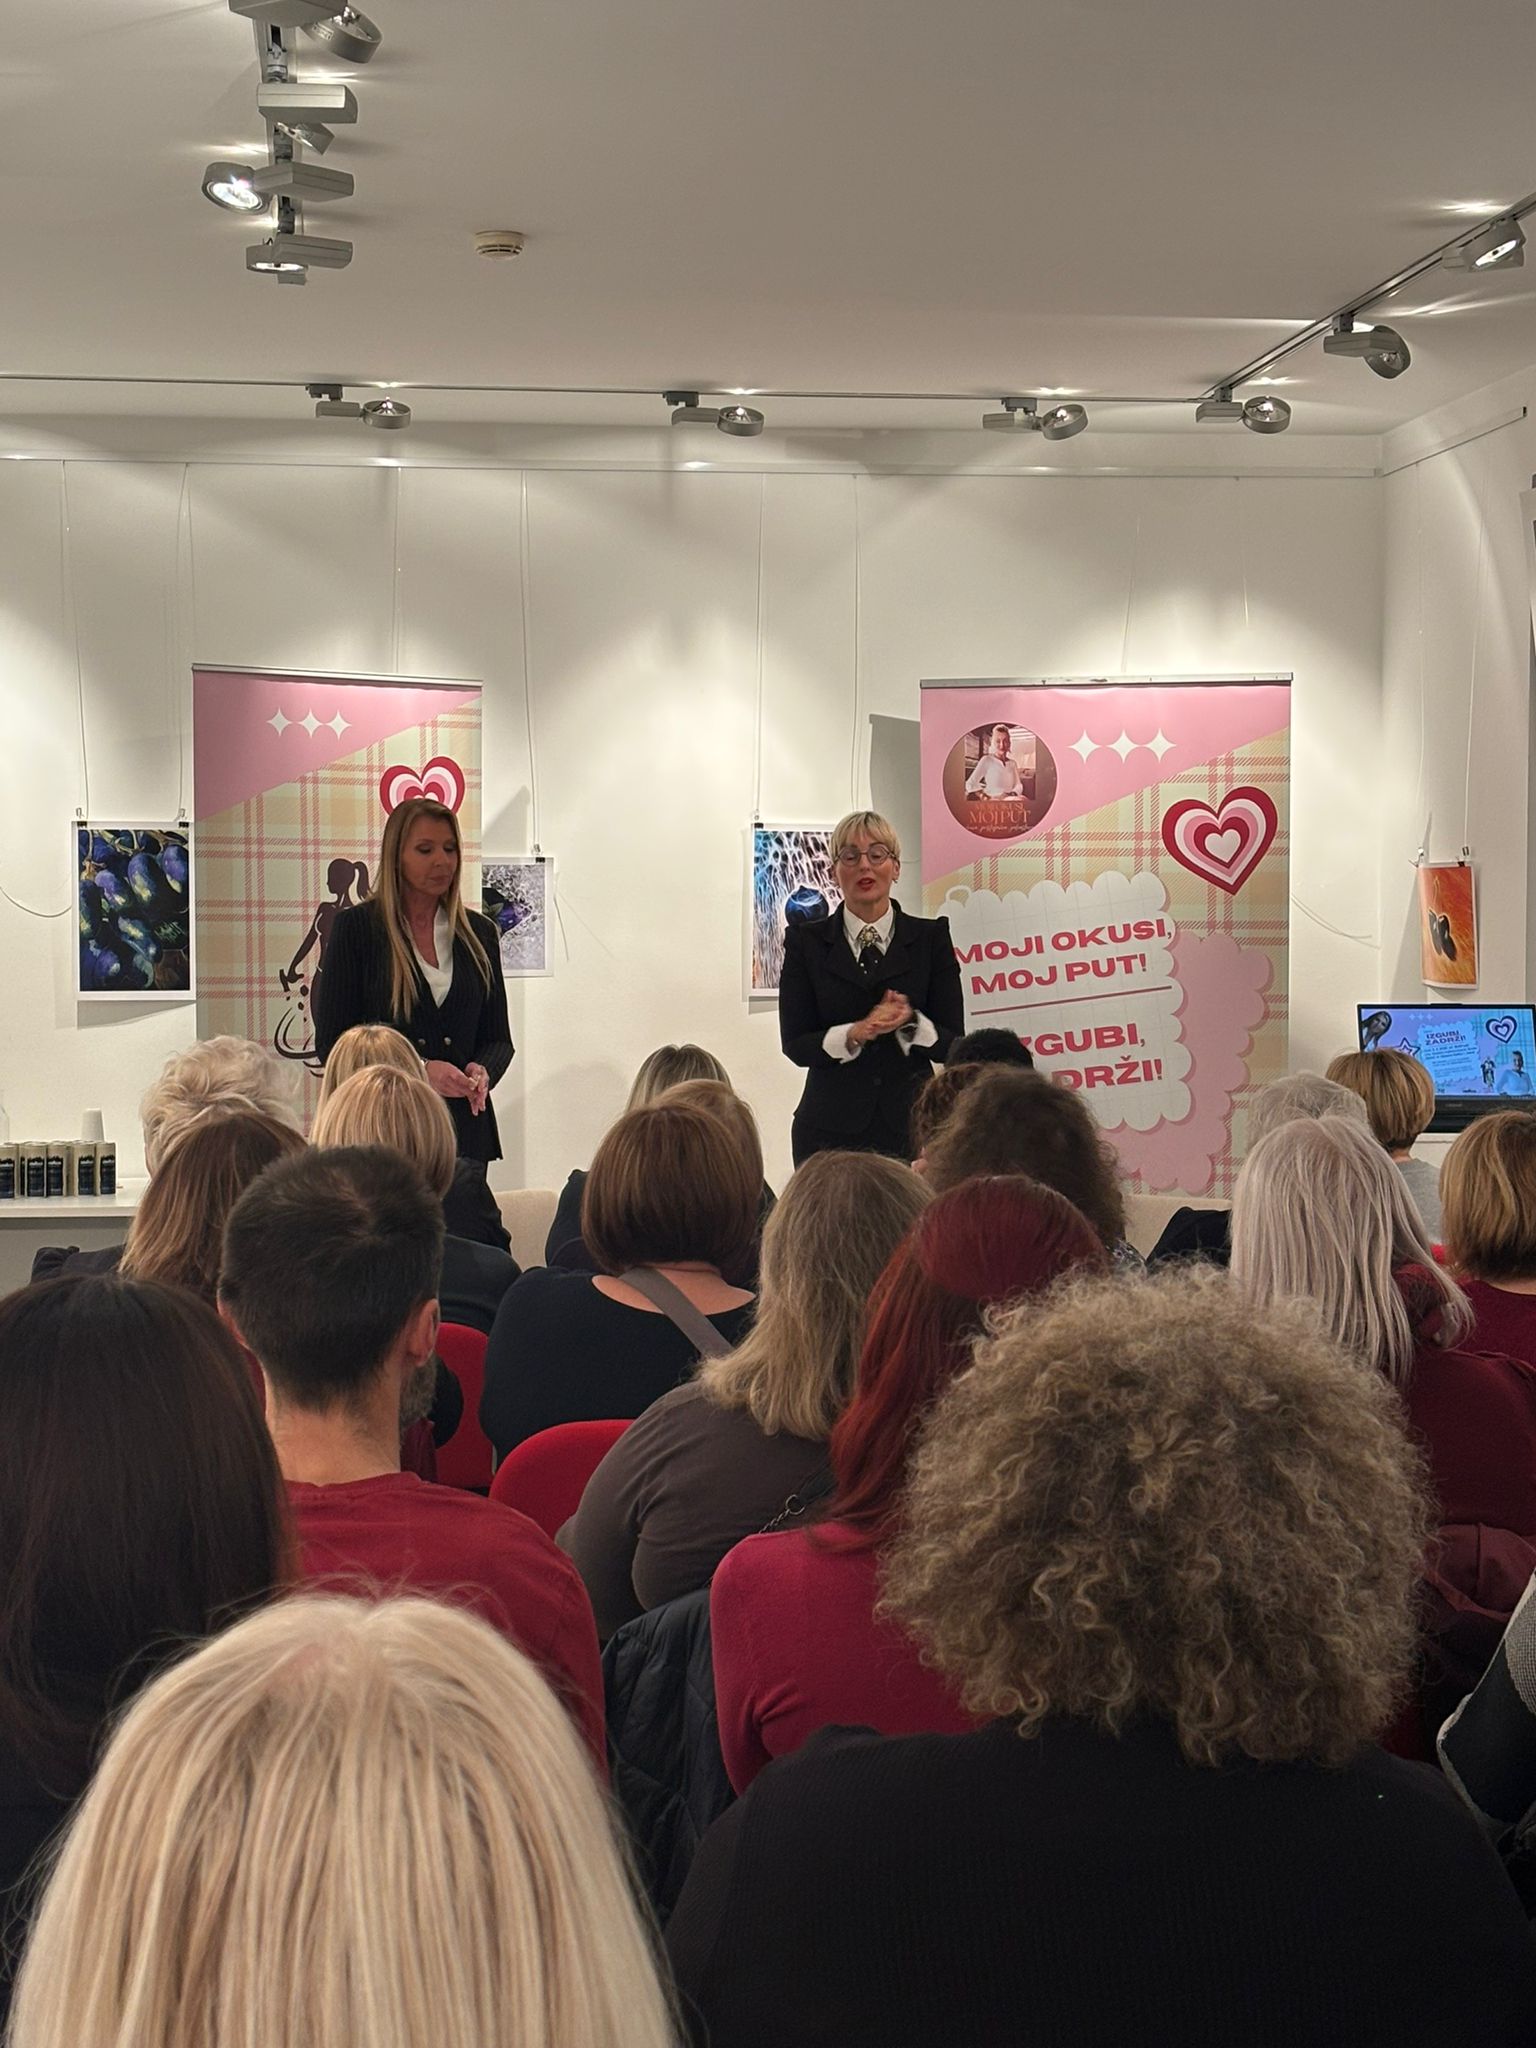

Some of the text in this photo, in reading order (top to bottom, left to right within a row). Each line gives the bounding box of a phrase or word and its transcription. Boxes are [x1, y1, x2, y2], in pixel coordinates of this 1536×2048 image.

[954, 919, 1172, 964] MOJI OKUSI,
[971, 953, 1147, 995] MOJ PUT!
[1019, 1023, 1145, 1056] GUBI,
[1051, 1055, 1163, 1091] DRŽI!
